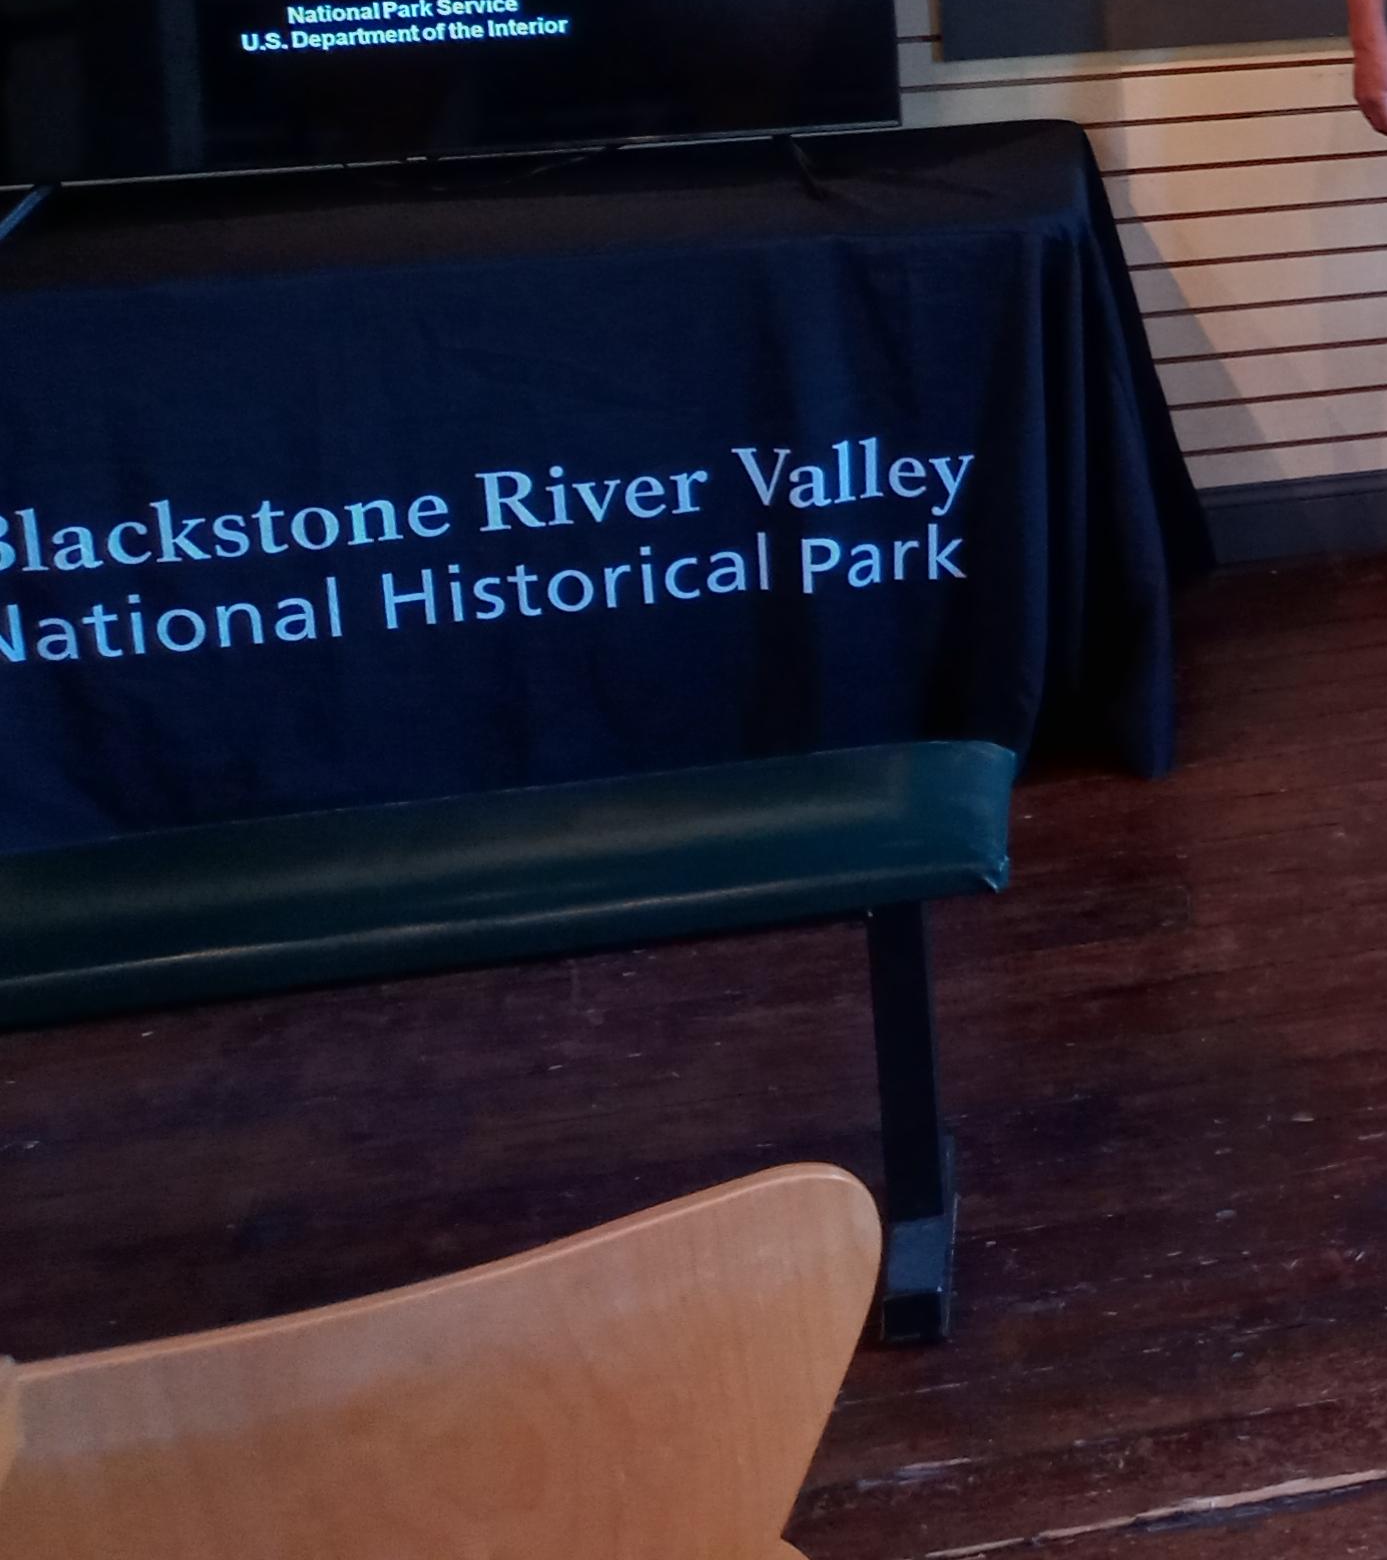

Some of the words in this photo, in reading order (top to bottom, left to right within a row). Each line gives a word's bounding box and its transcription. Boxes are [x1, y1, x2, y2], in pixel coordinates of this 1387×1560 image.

[241, 32, 288, 51] U.S.
[291, 25, 421, 51] Department
[422, 22, 447, 40] of
[448, 21, 485, 39] the
[487, 16, 569, 38] Interior
[287, 2, 380, 24] National
[382, 0, 434, 19] Park
[475, 466, 708, 532] River
[731, 437, 974, 515] Valley
[381, 531, 770, 630] Historical
[801, 523, 967, 594] Park
